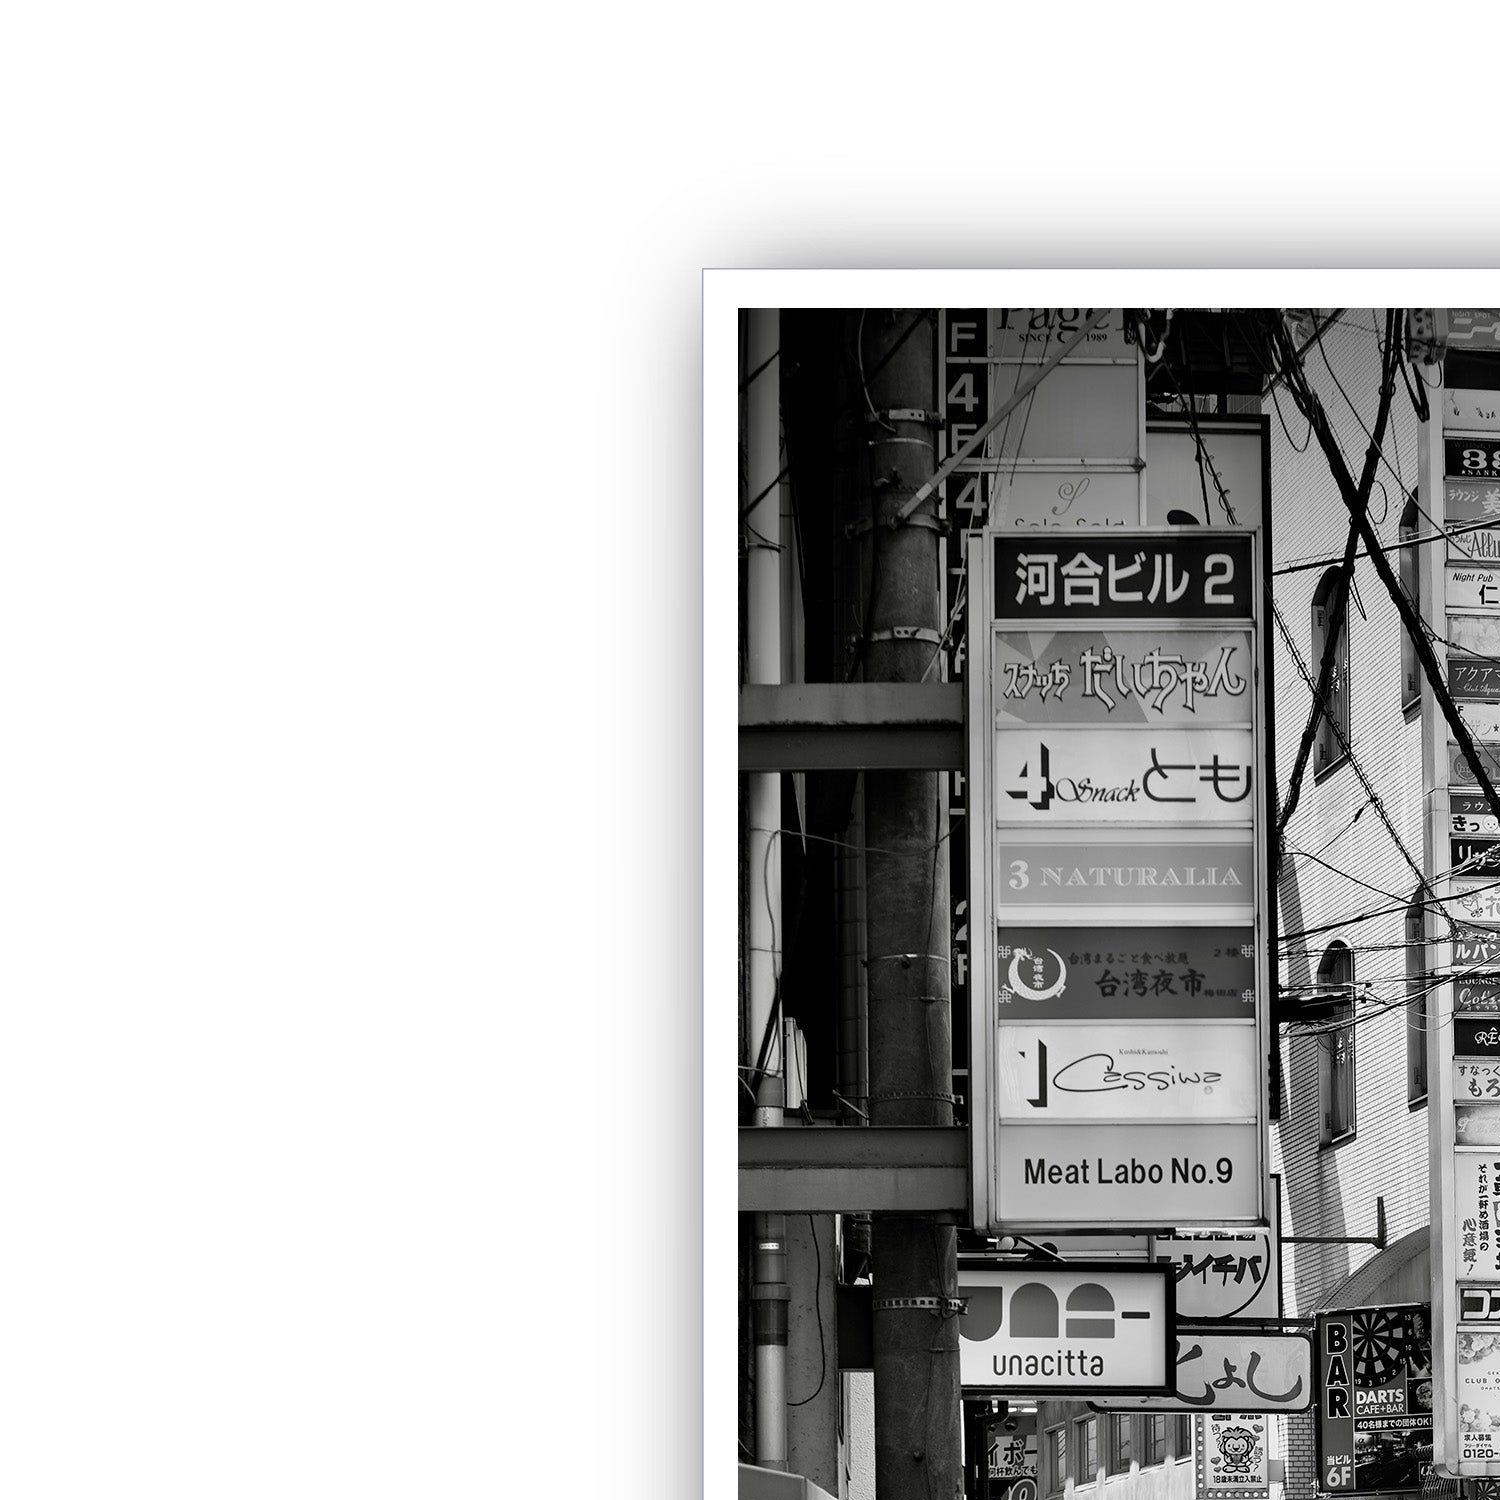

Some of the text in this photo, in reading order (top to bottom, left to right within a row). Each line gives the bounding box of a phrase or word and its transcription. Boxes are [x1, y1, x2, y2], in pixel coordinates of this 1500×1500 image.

[1085, 332, 1108, 343] 1989
[1448, 488, 1480, 502] ラウンジ
[1015, 551, 1236, 607] 河合ビル2
[1452, 572, 1494, 583] Night Pub
[1079, 645, 1247, 714] だいちゃん
[1005, 741, 1252, 811] 4 Snack とも
[1008, 860, 1243, 890] 3 NATURALIA
[1094, 968, 1207, 999] 台湾夜市
[1023, 1156, 1234, 1185] Meat Labo No.9
[992, 1349, 1105, 1378] unacitta
[1326, 1322, 1351, 1419] BAR
[1464, 1377, 1488, 1385] CLUB
[1355, 1388, 1405, 1405] DARTS
[1463, 1433, 1492, 1442] 求人募集
[1326, 1454, 1352, 1466] 当ビル
[1326, 1466, 1351, 1488] 6F
